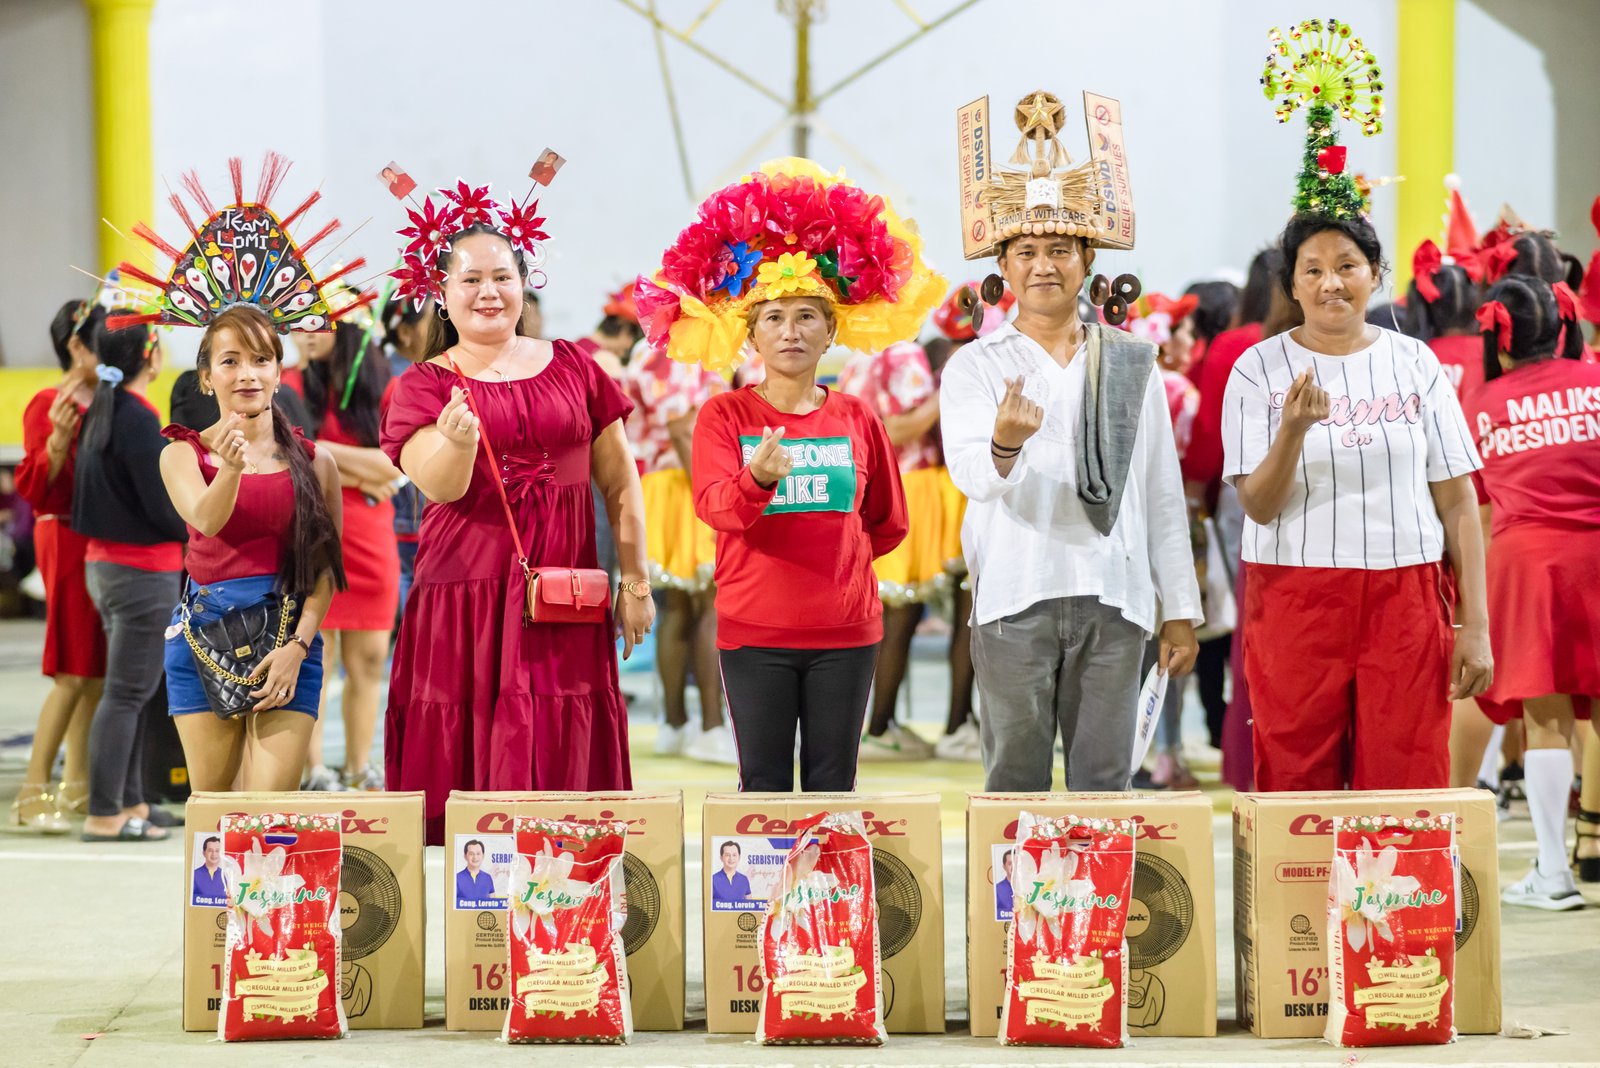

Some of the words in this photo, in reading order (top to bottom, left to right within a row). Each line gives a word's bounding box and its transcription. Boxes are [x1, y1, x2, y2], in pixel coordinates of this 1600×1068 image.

[961, 112, 970, 152] RELIEF
[973, 126, 985, 181] DSWD
[1113, 144, 1128, 196] SUPPLIES
[962, 154, 973, 210] SUPPLIES
[222, 208, 270, 232] TEAM
[1034, 209, 1058, 219] WITH
[1061, 210, 1086, 222] CARE
[1119, 198, 1130, 238] RELIEF
[217, 230, 268, 250] LOMI
[1480, 412, 1600, 459] PRESIDEN
[1282, 867, 1314, 877] MODEL:
[1316, 867, 1331, 877] PF-
[196, 896, 214, 904] Cong.
[1352, 886, 1446, 912] Jasmine
[1084, 970, 1096, 978] RICE
[1036, 988, 1065, 996] REGULAR
[1067, 990, 1088, 999] MILLED
[470, 998, 498, 1010] DESK
[730, 1000, 760, 1013] DESK
[1040, 1008, 1060, 1016] SPECIAL
[1284, 1003, 1314, 1017] DESK
